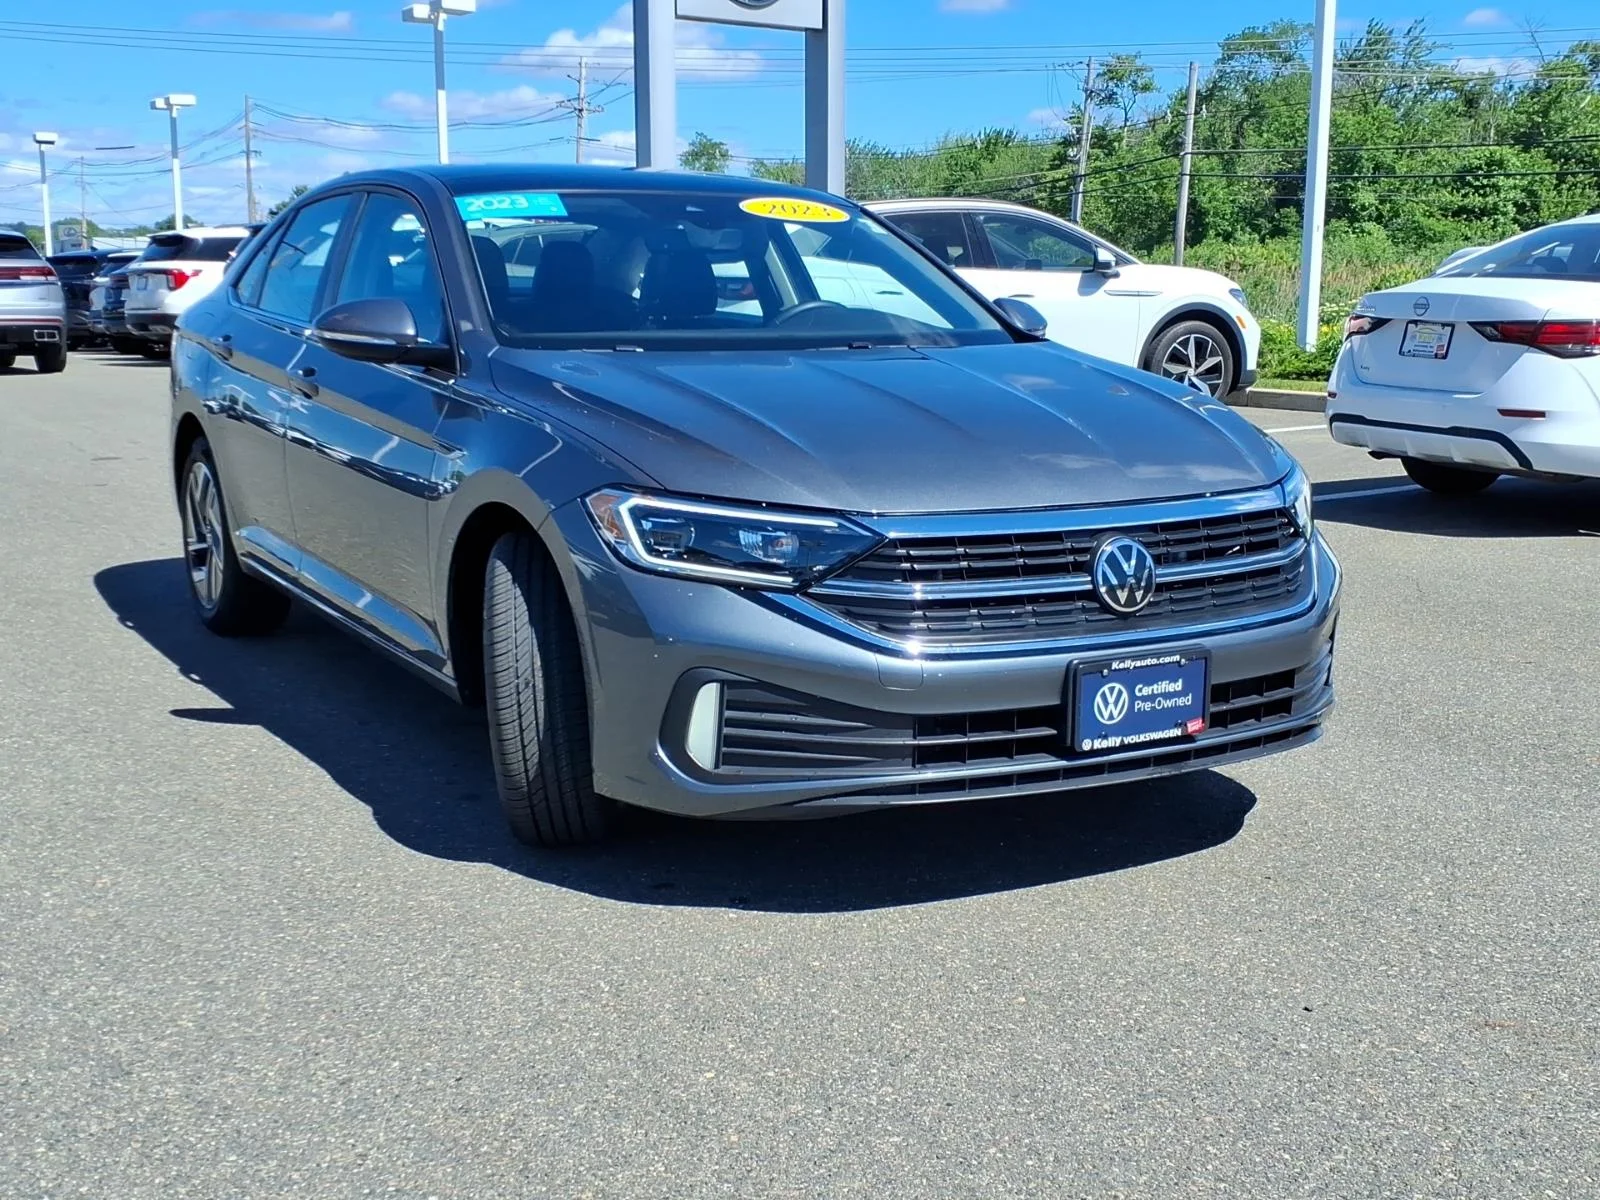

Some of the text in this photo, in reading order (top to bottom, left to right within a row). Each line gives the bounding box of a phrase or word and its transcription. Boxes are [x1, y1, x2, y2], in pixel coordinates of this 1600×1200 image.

[464, 195, 529, 212] 2023
[1111, 655, 1180, 670] Kellyauto.com
[1134, 679, 1183, 697] Certified
[1134, 693, 1192, 712] Pre-Owned
[1093, 735, 1121, 750] Kelly
[1123, 728, 1182, 745] VOLKSWAGEN
